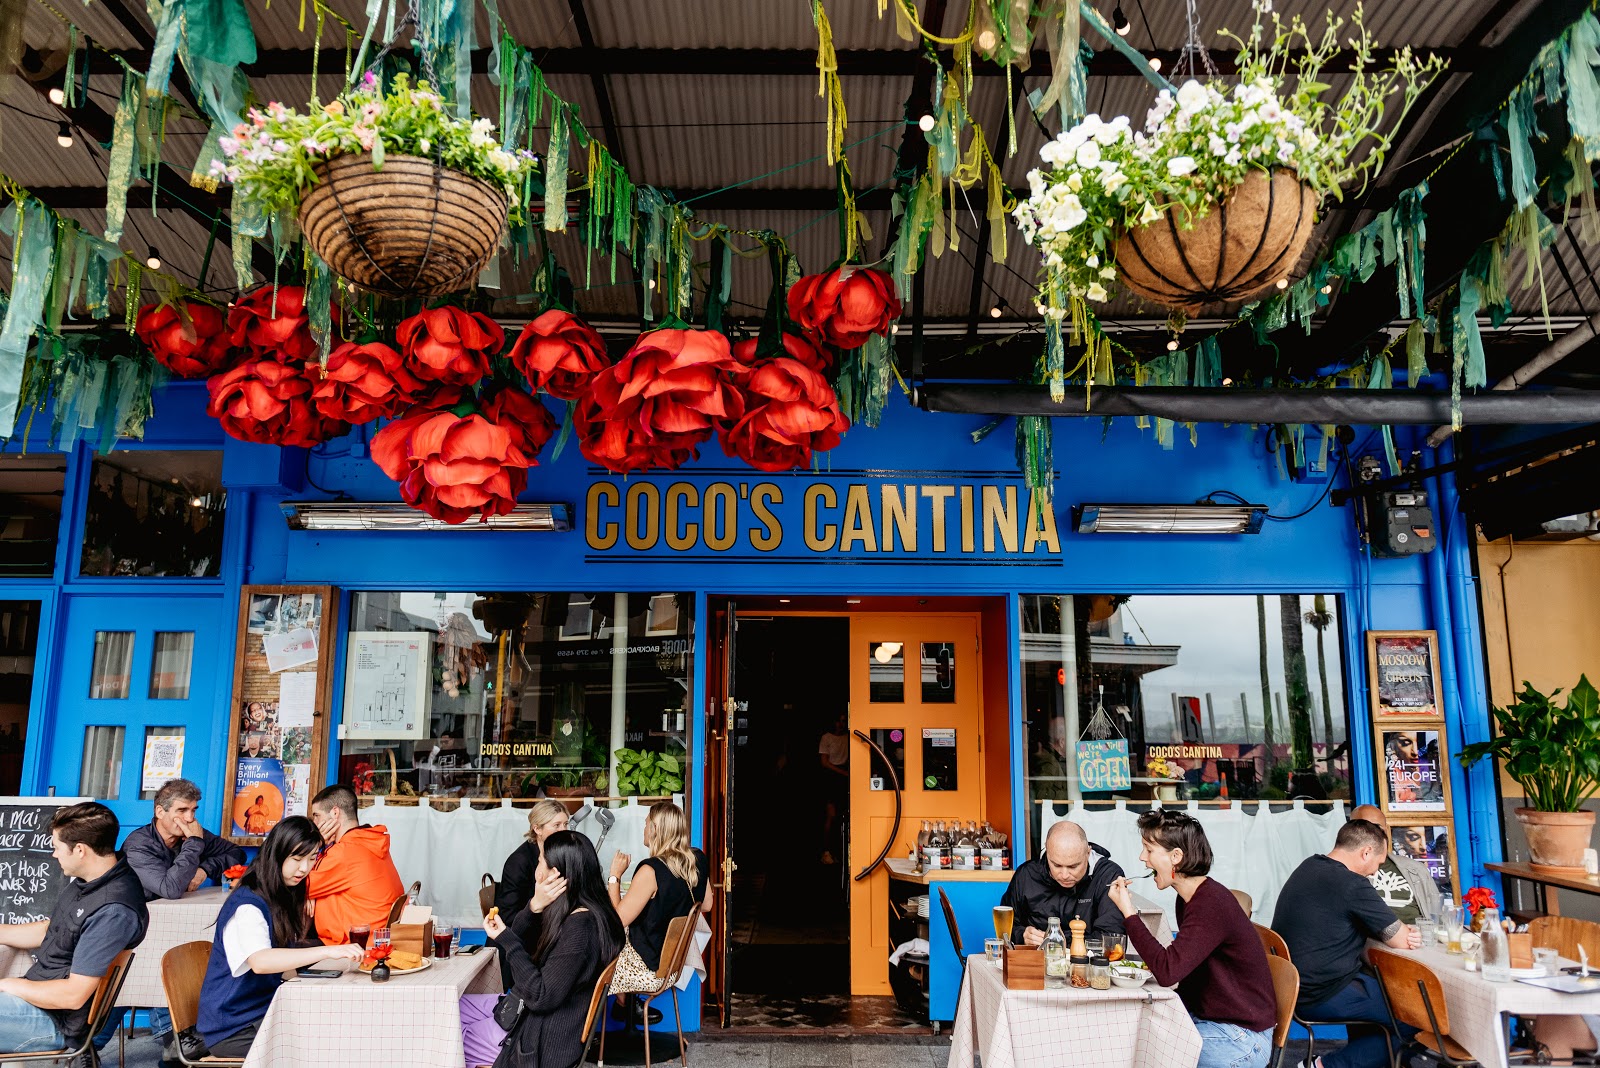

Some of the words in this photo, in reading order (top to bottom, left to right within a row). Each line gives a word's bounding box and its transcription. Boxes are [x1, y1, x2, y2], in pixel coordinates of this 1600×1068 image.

[584, 482, 784, 552] COCO'S
[803, 483, 1063, 553] CANTINA
[1379, 654, 1426, 666] MOSCOW
[1385, 672, 1423, 682] CIRCUS
[480, 743, 511, 756] COCO'S
[513, 743, 553, 756] CANTINA
[1149, 745, 1180, 758] COCO'S
[1182, 745, 1223, 758] CANTINA
[238, 762, 262, 772] Every
[1080, 756, 1131, 789] OPEN
[237, 770, 269, 779] Brilliant
[1389, 771, 1438, 782] EUROPE
[236, 778, 260, 788] Thing
